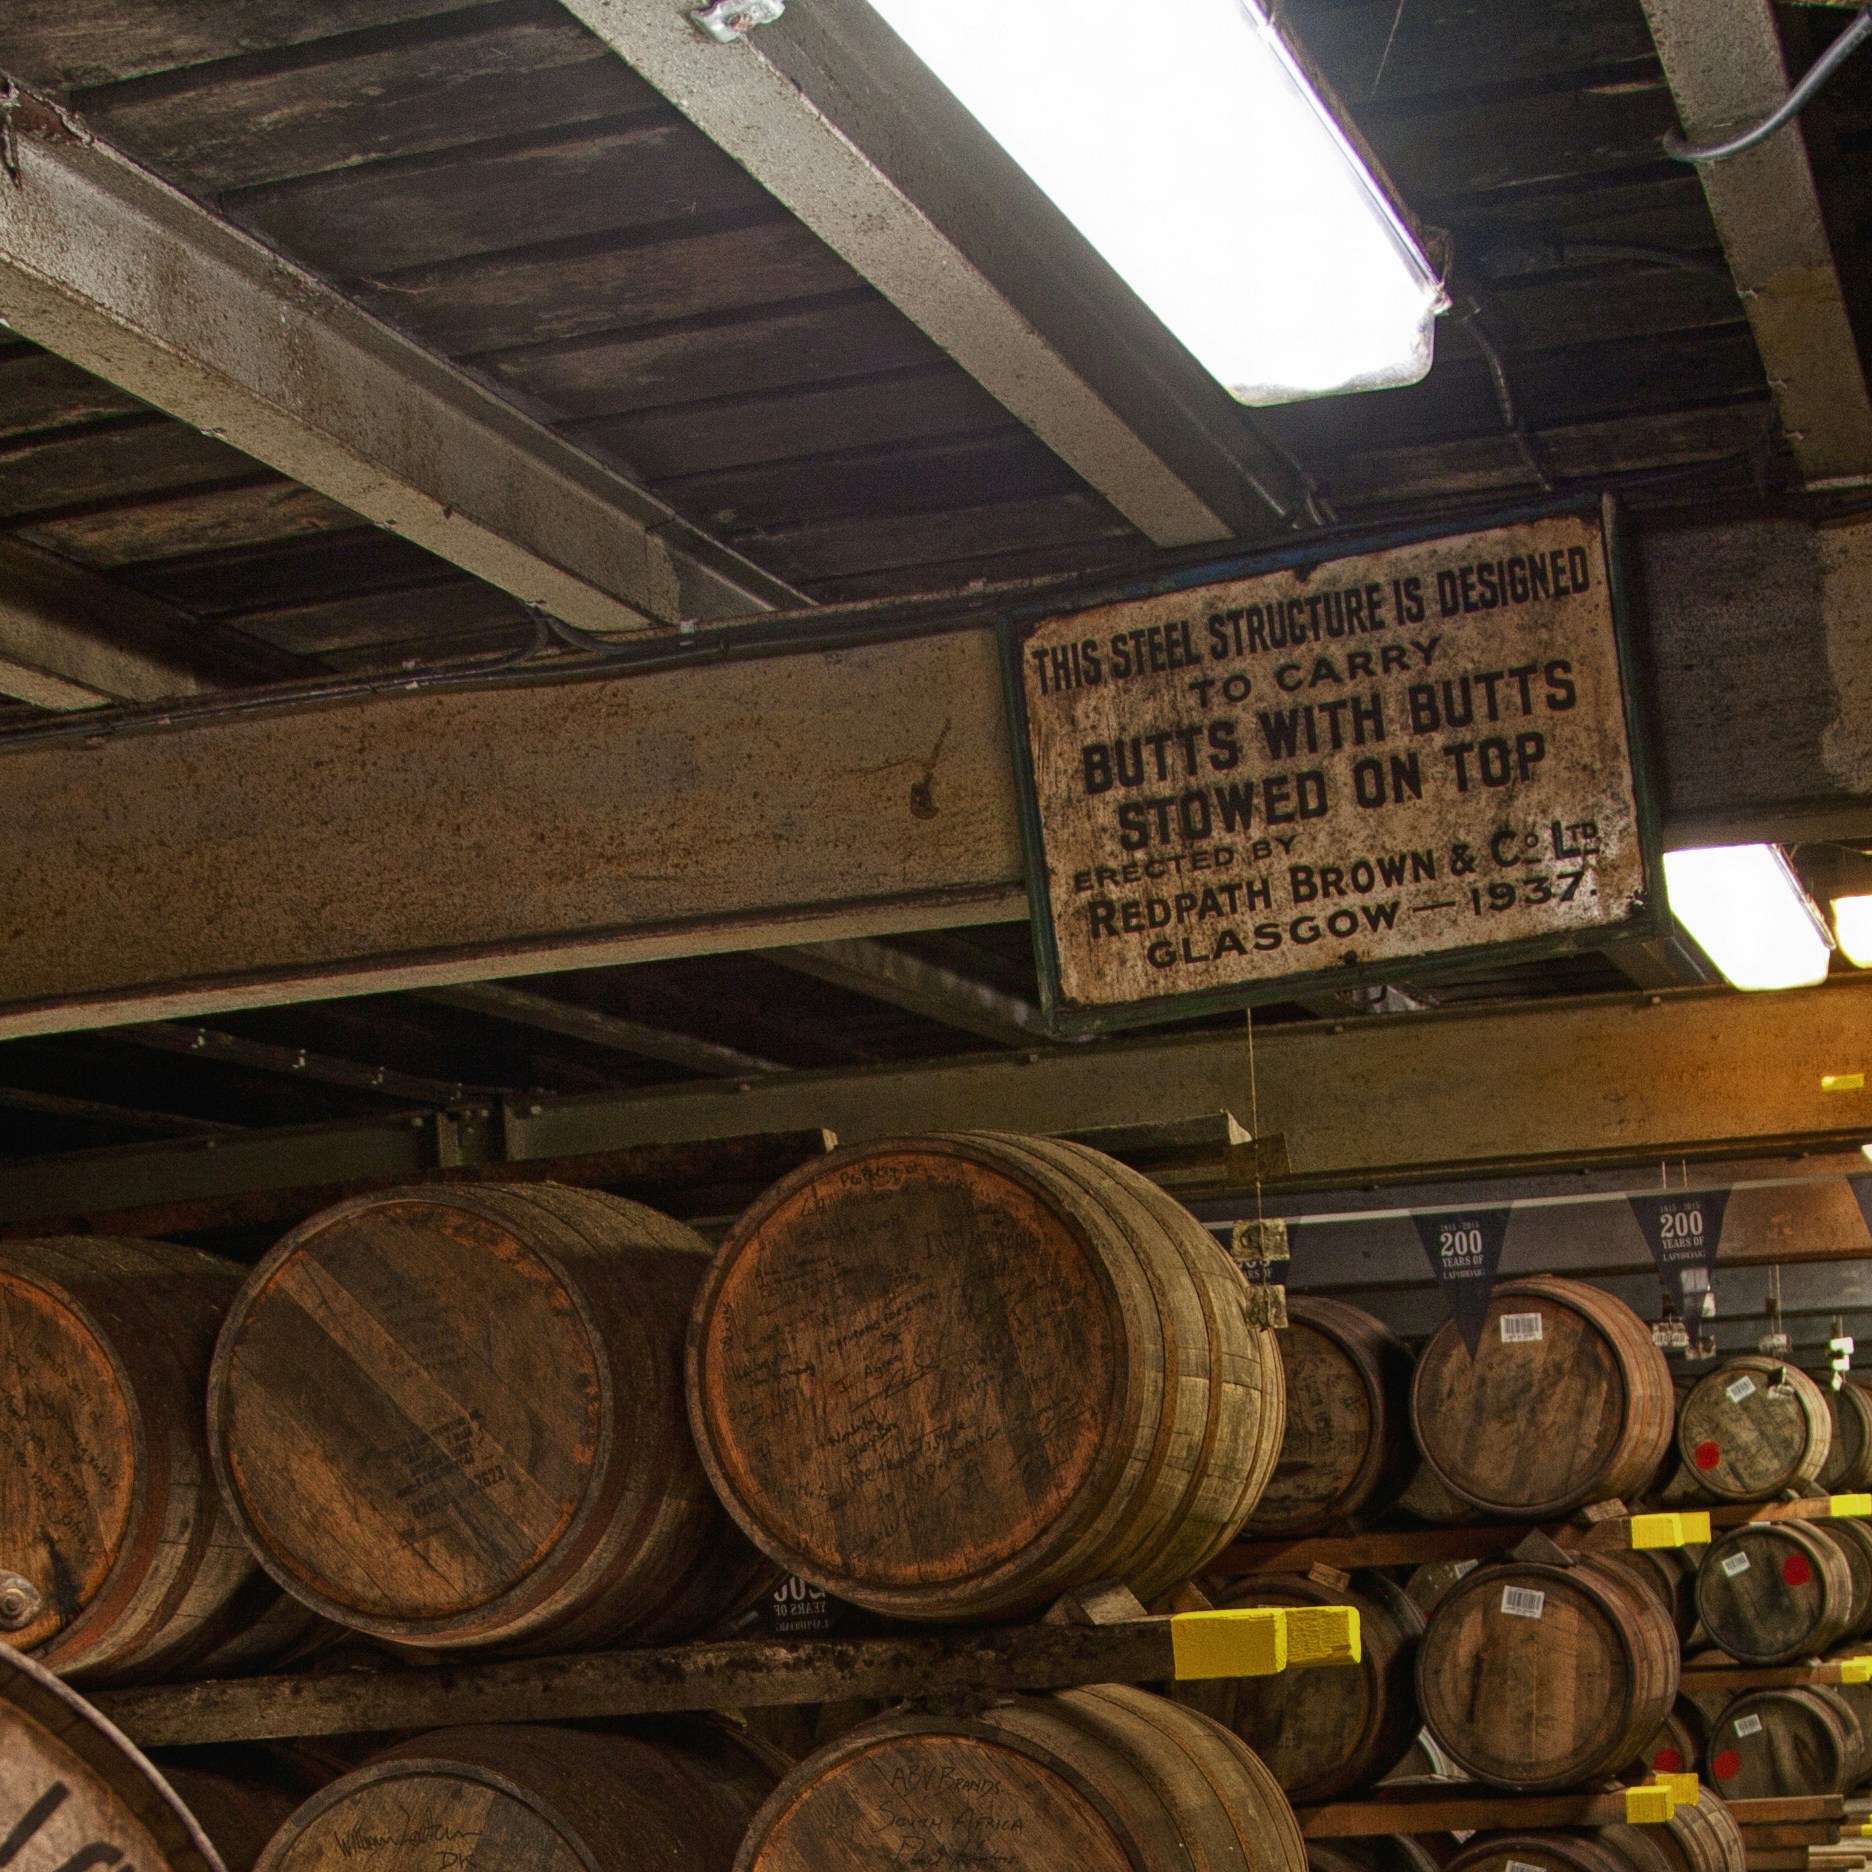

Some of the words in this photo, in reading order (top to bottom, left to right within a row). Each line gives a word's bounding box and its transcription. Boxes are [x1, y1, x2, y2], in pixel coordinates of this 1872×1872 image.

[1032, 637, 1102, 696] THIS
[1108, 619, 1201, 680] STEEL
[1208, 584, 1386, 662] STRUCTURE
[1394, 576, 1426, 625] IS
[1436, 545, 1591, 618] DESIGNED
[1188, 674, 1253, 709] TO
[1277, 636, 1444, 694] CARRY
[1082, 722, 1246, 796] BUTTS
[1258, 693, 1386, 760] WITH
[1408, 658, 1577, 736] BUTTS
[1117, 768, 1328, 851] STOWED
[1352, 749, 1424, 810] ON
[1442, 730, 1547, 793] TOP
[1073, 846, 1235, 894] ERECTED
[1252, 833, 1298, 864] BY
[1088, 875, 1274, 940] REDPATH
[1288, 848, 1438, 904] BROWN
[1450, 841, 1478, 876] &
[1145, 899, 1400, 970] GLASGOW
[1440, 1229, 1483, 1257] 200
[1659, 1210, 1703, 1239] 200
[1661, 1236, 1692, 1250] YEARS
[1693, 1236, 1705, 1246] OF
[1442, 1256, 1471, 1268] YEARS
[1472, 1254, 1485, 1265] OF
